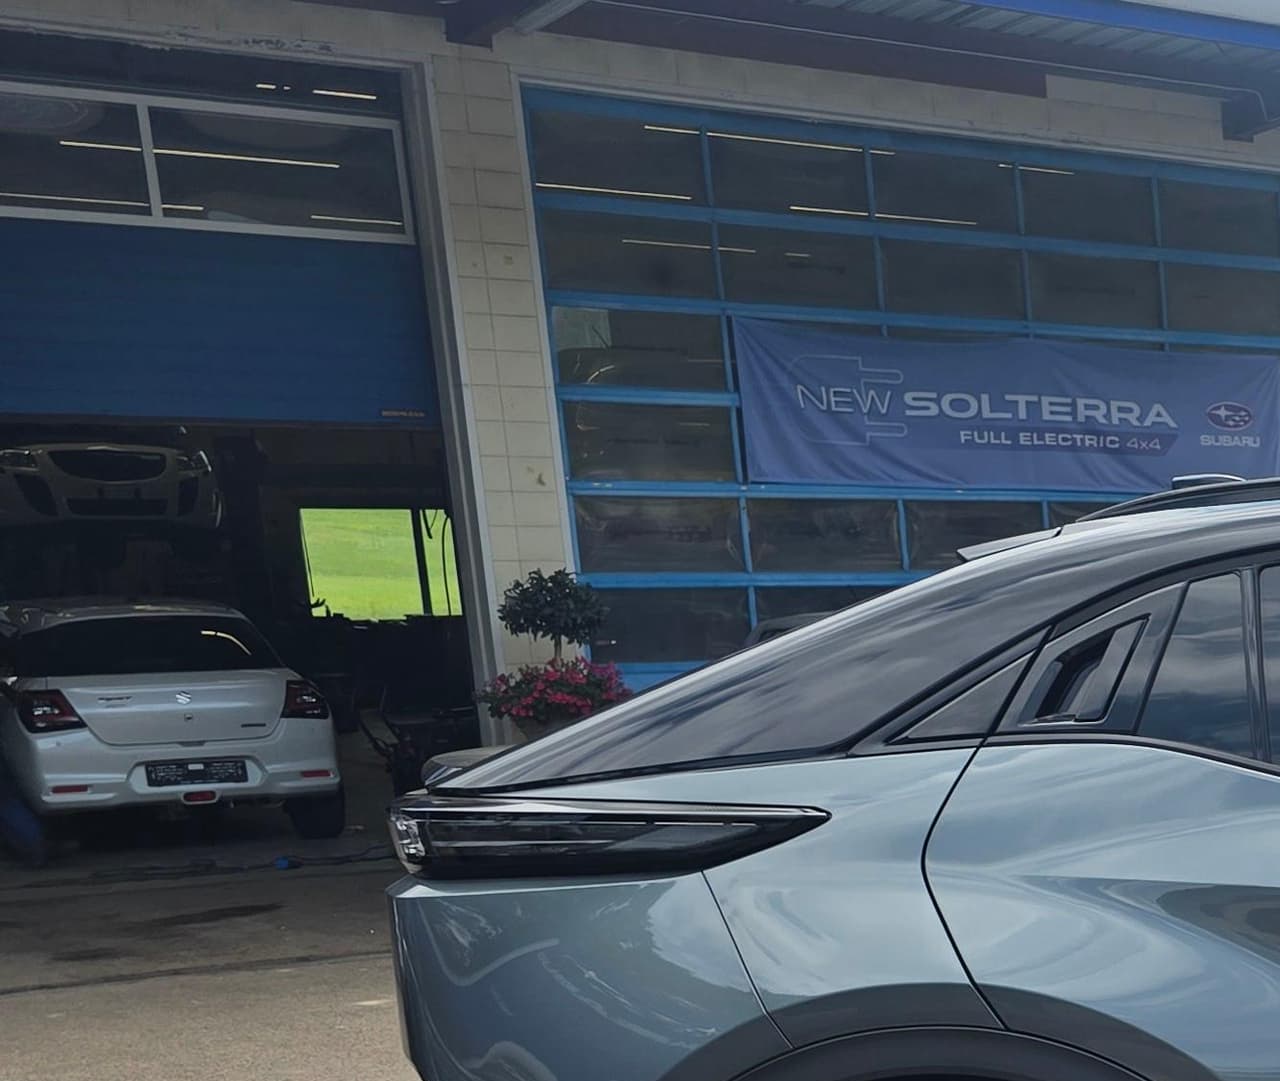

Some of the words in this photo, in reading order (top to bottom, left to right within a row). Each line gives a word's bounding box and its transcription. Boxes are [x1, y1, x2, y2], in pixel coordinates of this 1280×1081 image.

[796, 384, 892, 415] NEW
[903, 390, 1179, 428] SOLTERRA
[959, 430, 1012, 445] FULL
[1019, 432, 1120, 449] ELECTRIC
[1126, 437, 1162, 450] 4x4
[1200, 434, 1261, 448] SUBARU
